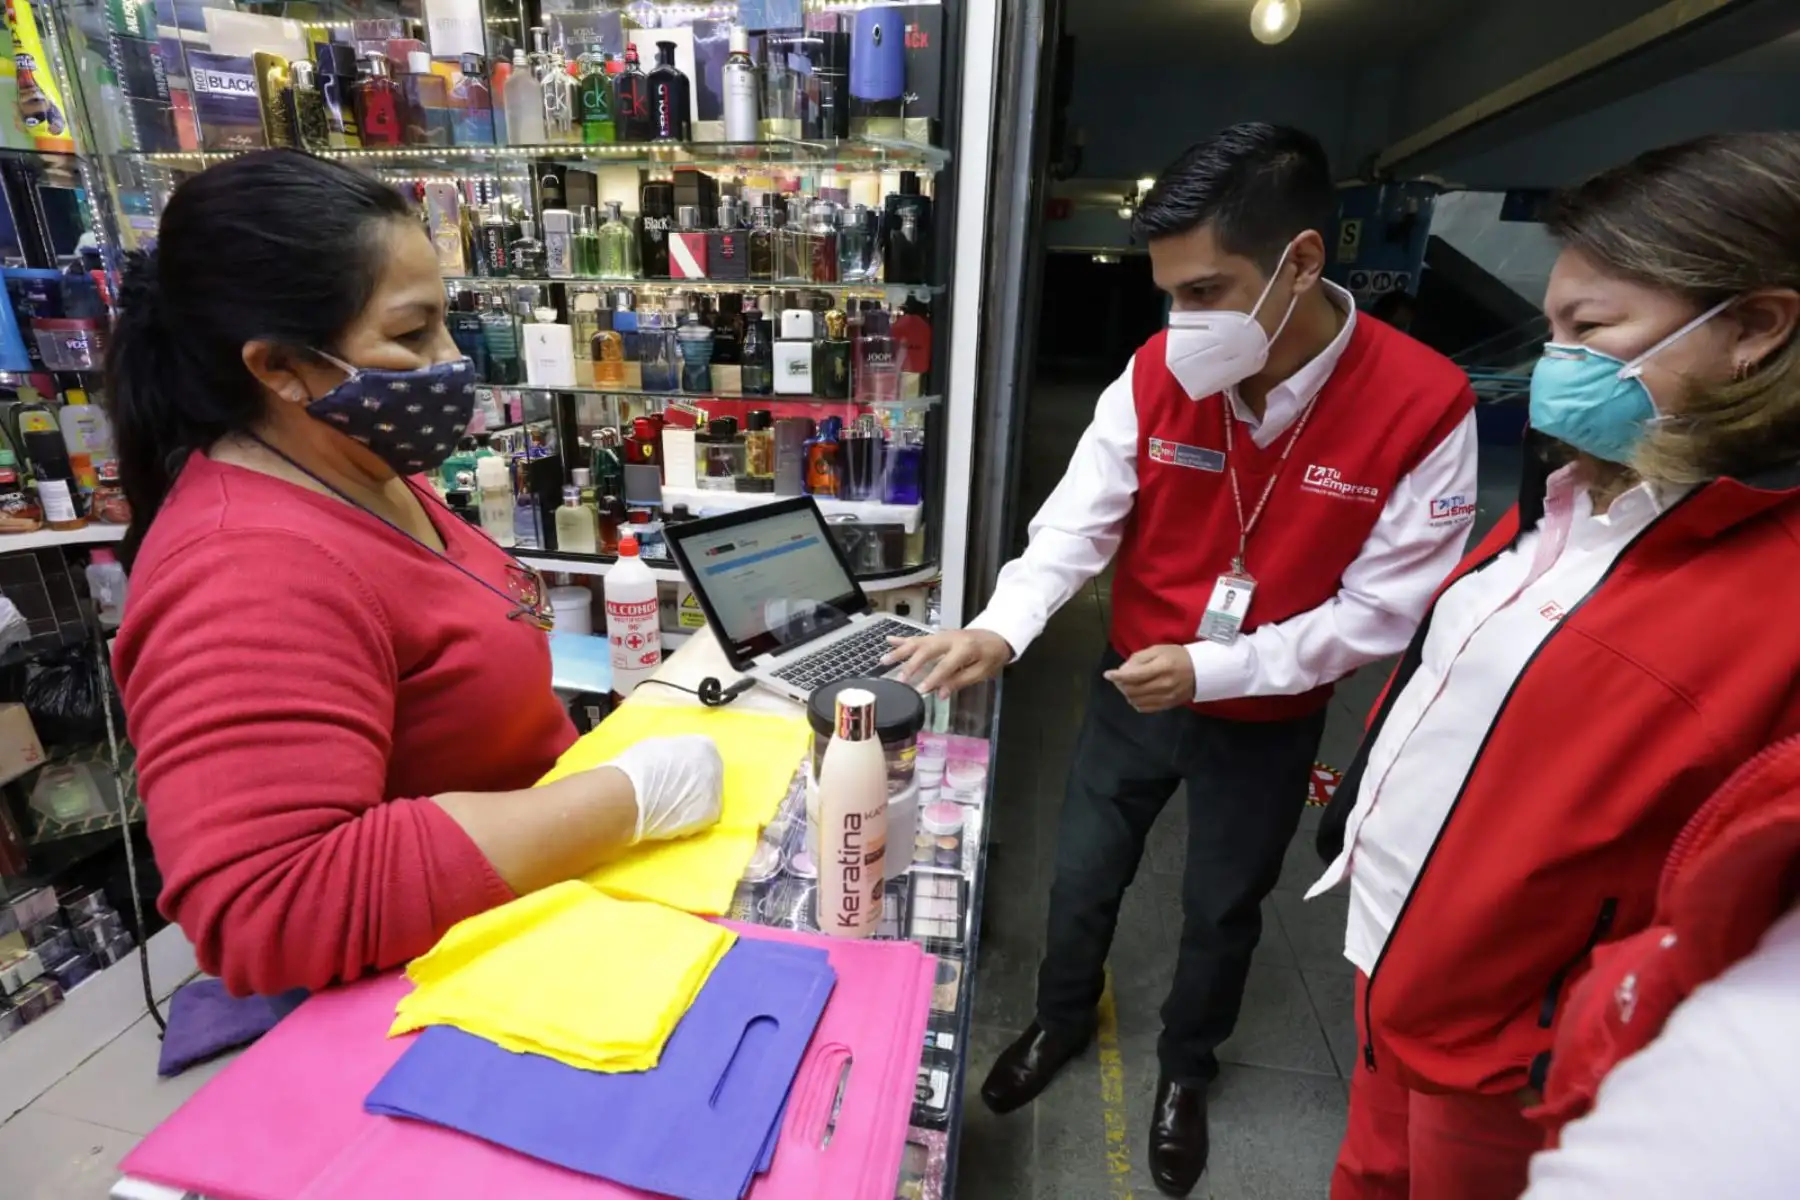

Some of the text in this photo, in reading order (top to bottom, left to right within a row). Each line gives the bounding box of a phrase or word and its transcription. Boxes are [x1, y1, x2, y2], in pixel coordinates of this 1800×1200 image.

[208, 74, 257, 94] BLACK
[1327, 468, 1342, 480] Tu
[1322, 477, 1379, 497] Empresa
[607, 600, 657, 616] ALCOHOL
[837, 812, 862, 928] Keratina
